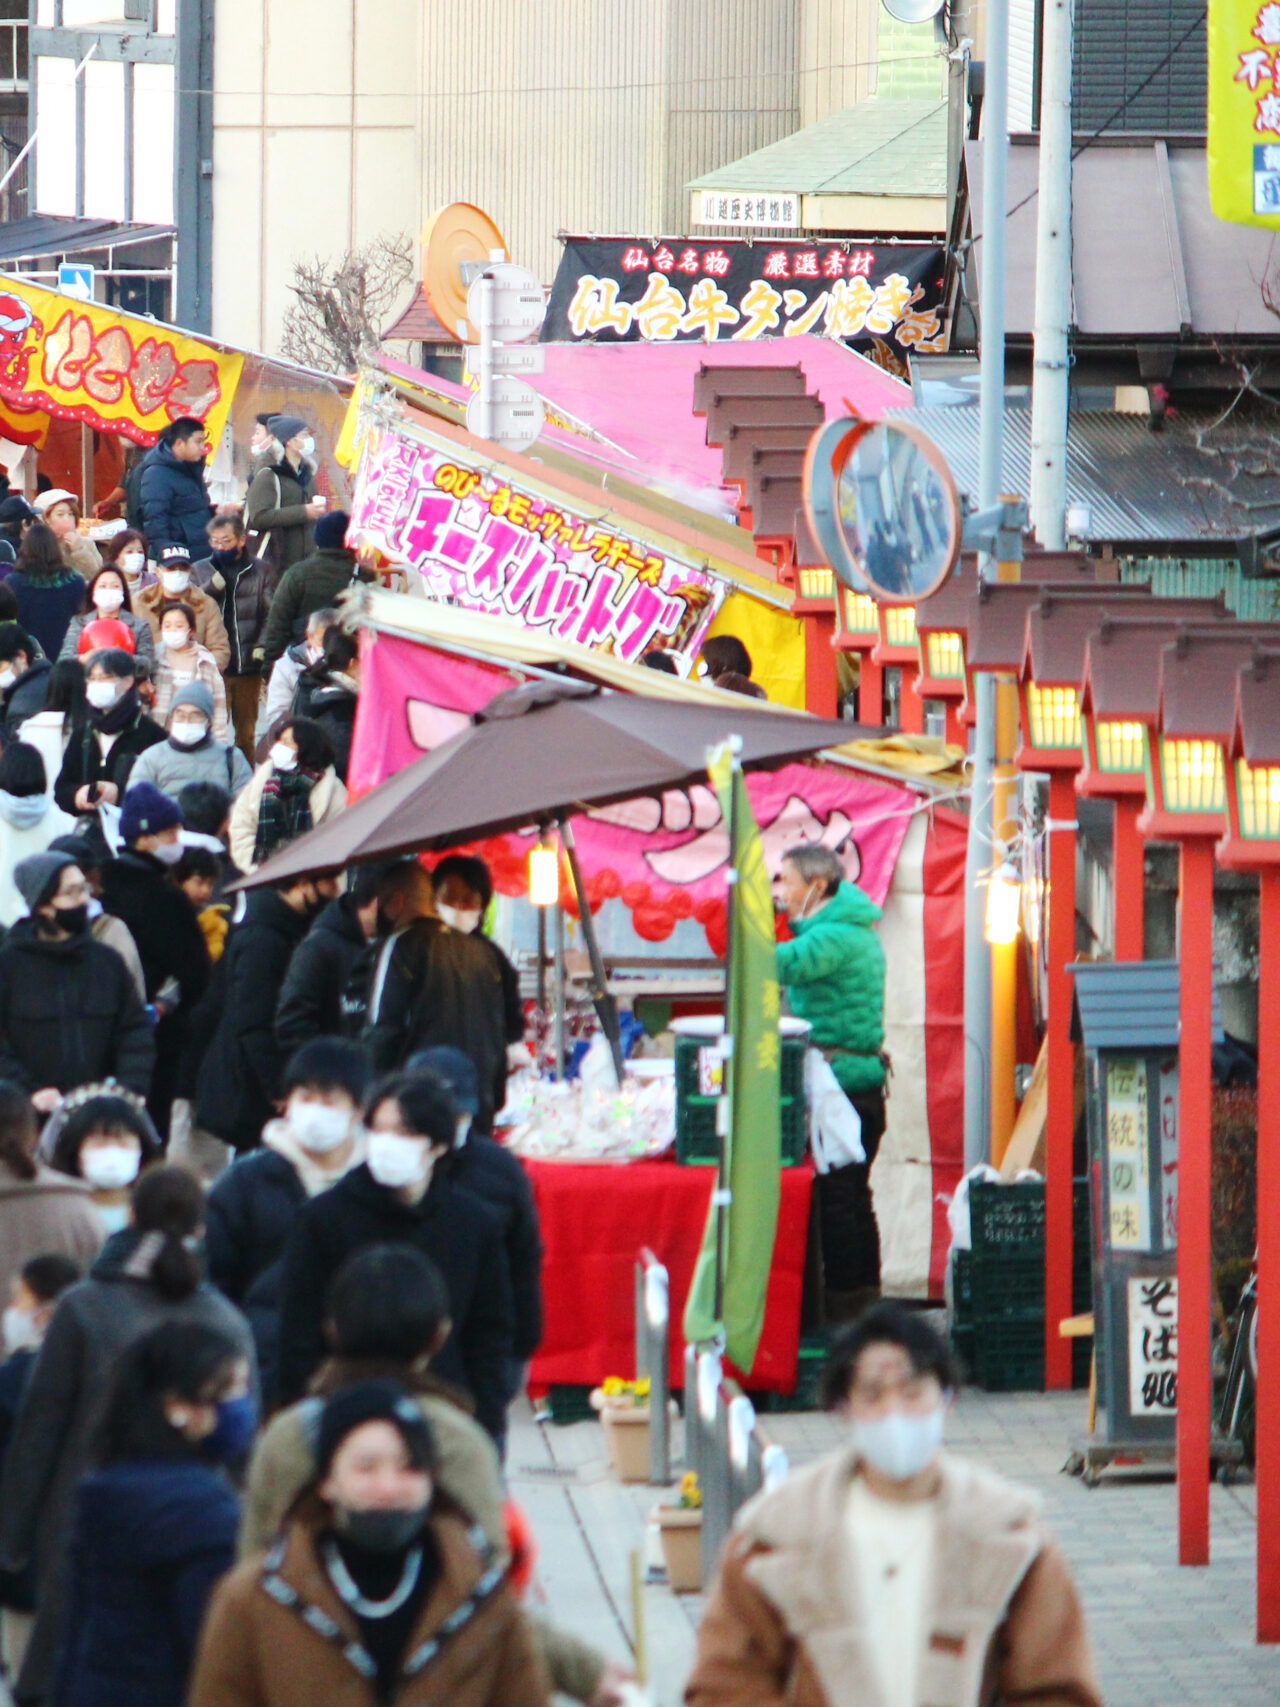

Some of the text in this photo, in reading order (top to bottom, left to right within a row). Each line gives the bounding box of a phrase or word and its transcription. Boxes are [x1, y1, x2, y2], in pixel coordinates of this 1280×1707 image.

[622, 246, 876, 278] 仙台名物 厳選素材
[569, 273, 911, 341] 仙台牛タン焼き
[1108, 1062, 1138, 1243] 伝統の味
